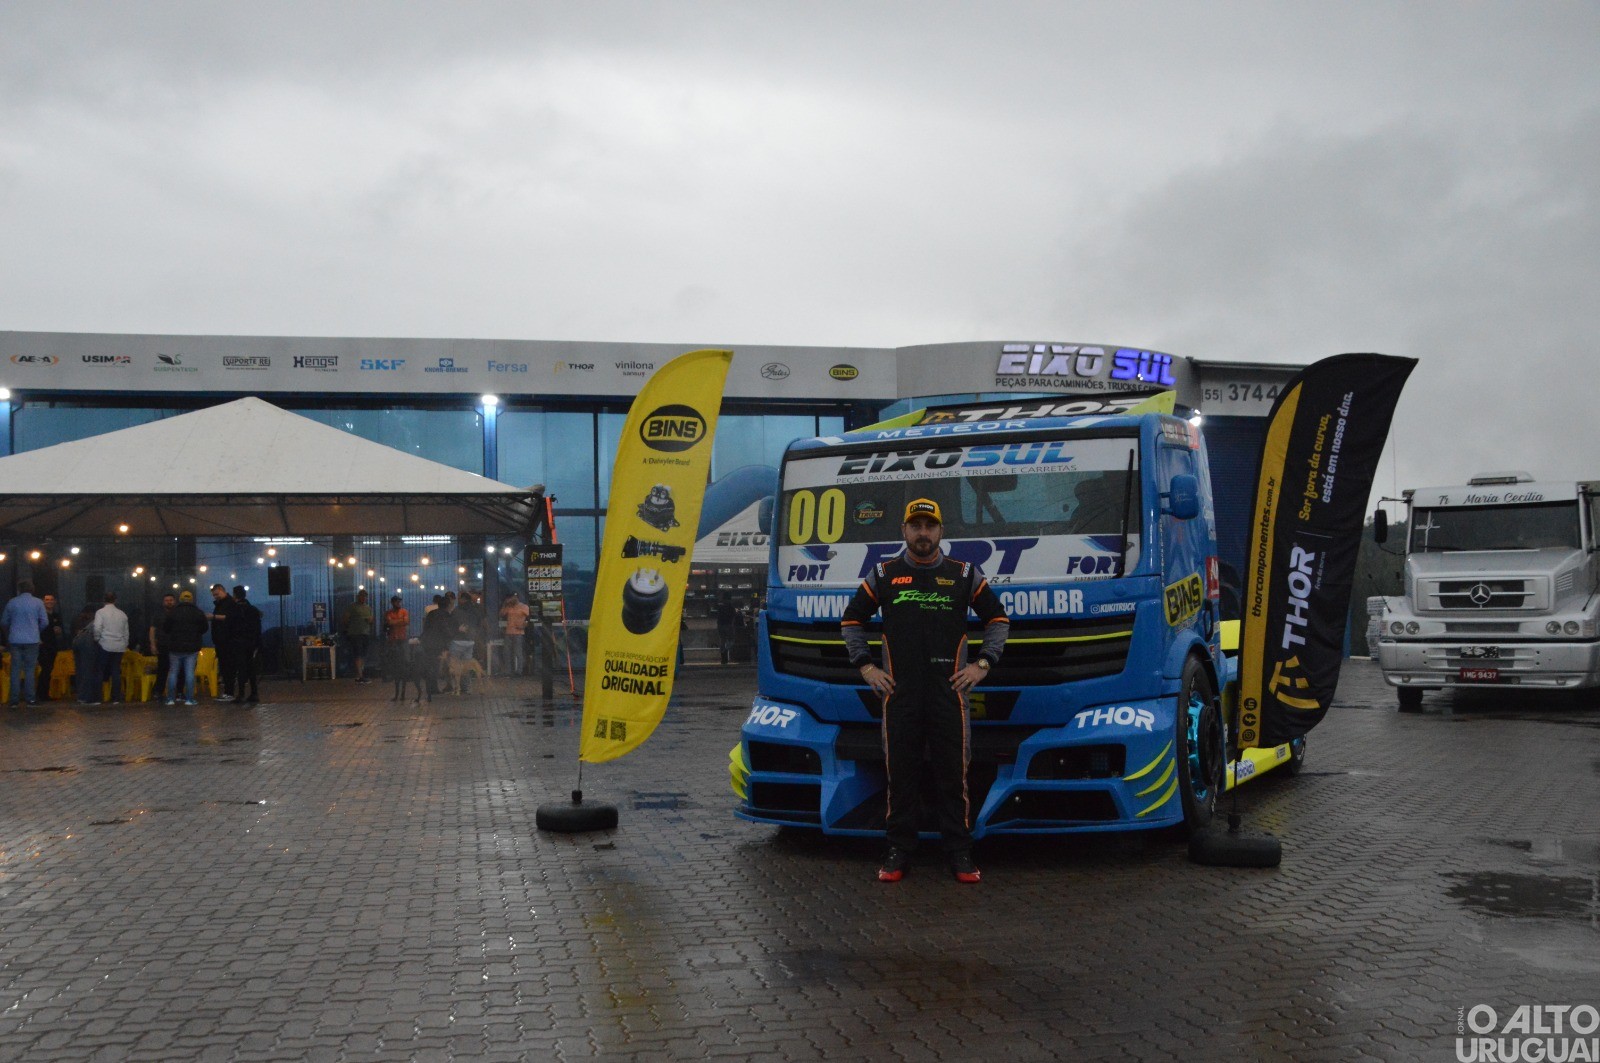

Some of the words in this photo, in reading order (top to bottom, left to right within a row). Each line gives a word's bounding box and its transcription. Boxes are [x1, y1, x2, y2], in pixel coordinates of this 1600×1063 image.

[225, 358, 257, 366] SUPORTE
[293, 355, 339, 369] Hengst
[359, 359, 406, 371] SKF
[486, 359, 528, 373] Fersa
[614, 360, 654, 370] vinilona
[995, 343, 1105, 378] EIXO
[1110, 348, 1177, 386] SUL
[995, 378, 1026, 389] PEÇAS
[1028, 379, 1053, 388] PARA
[1228, 383, 1279, 402] 3744
[1336, 391, 1354, 418] dna.
[648, 419, 698, 439] BINS
[877, 420, 1027, 439] METEOR
[1331, 417, 1347, 454] nosso
[1307, 453, 1321, 470] da
[1327, 454, 1339, 474] em
[836, 476, 865, 485] PEÇAS
[867, 474, 893, 482] PARA
[965, 467, 1008, 476] TRUCKS
[1020, 464, 1077, 473] CARRETAS
[1303, 470, 1319, 500] fora
[1321, 473, 1335, 504] está
[1462, 492, 1501, 505] Maria
[788, 488, 846, 545] 00
[1298, 498, 1312, 521] Ser
[1251, 476, 1276, 618] thorcomponentes.com.br
[857, 538, 1039, 579] FRT
[787, 564, 830, 581] FORT
[1165, 576, 1202, 624] BINS
[1281, 545, 1316, 650] THOR
[604, 659, 668, 678] QUALIDADE
[601, 675, 666, 696] ORIGINAL
[746, 705, 798, 729] HOR
[1074, 706, 1155, 732] THOR
